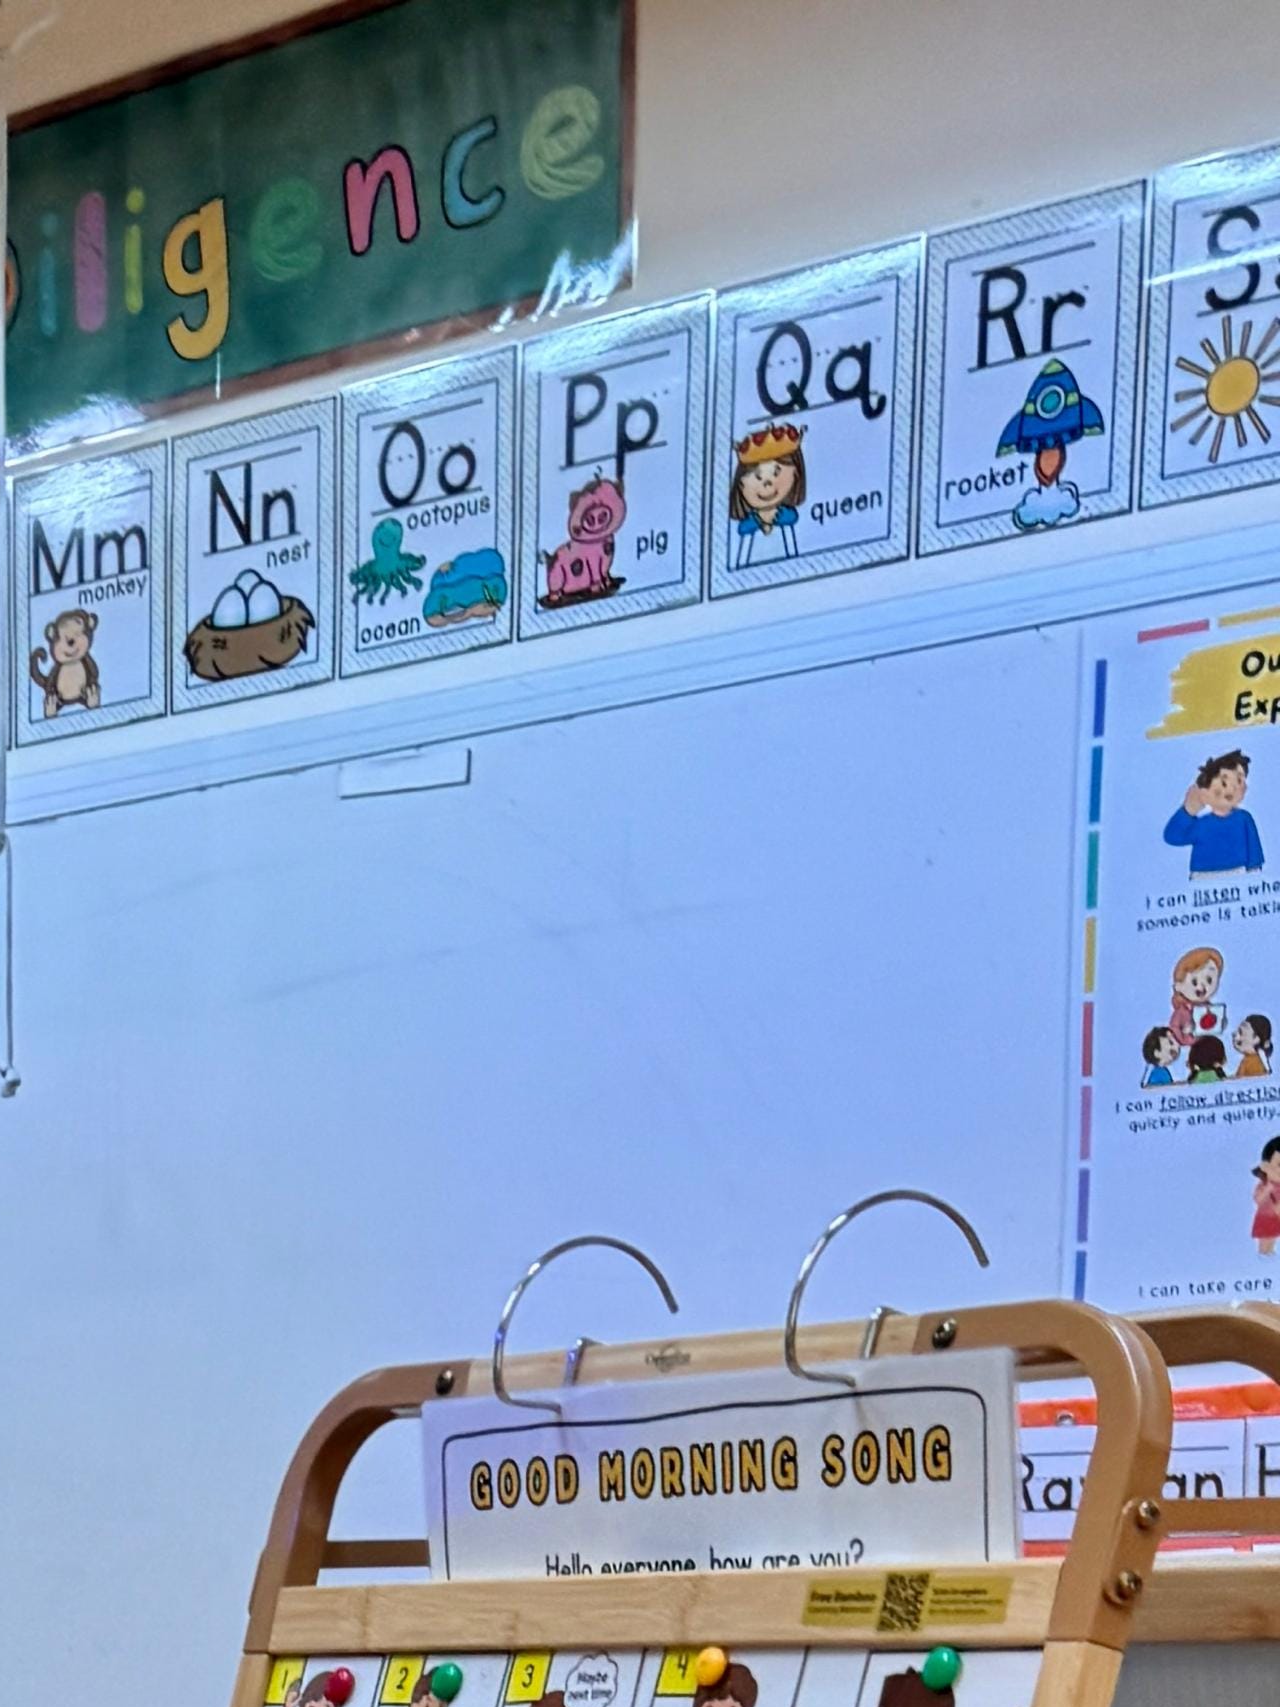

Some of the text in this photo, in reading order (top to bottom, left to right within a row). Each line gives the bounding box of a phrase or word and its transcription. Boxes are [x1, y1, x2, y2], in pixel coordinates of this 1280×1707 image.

[976, 264, 1087, 369] Rr
[755, 321, 888, 420] Qq
[564, 372, 659, 481] Pp
[378, 421, 476, 507] Oo
[944, 460, 1029, 500] rocket
[209, 462, 297, 554] Nn
[810, 489, 883, 523] queen
[32, 517, 148, 594] Mm
[266, 540, 312, 568] nest
[635, 528, 669, 561] pig
[77, 574, 148, 606] monkey
[1157, 893, 1187, 908] can
[1137, 911, 1211, 932] someone
[1125, 1099, 1153, 1112] can
[1187, 1111, 1216, 1126] and
[1150, 1277, 1273, 1298] can take care
[469, 1425, 952, 1510] GOOD MORNING SONG
[396, 1664, 535, 1691] 2 3
